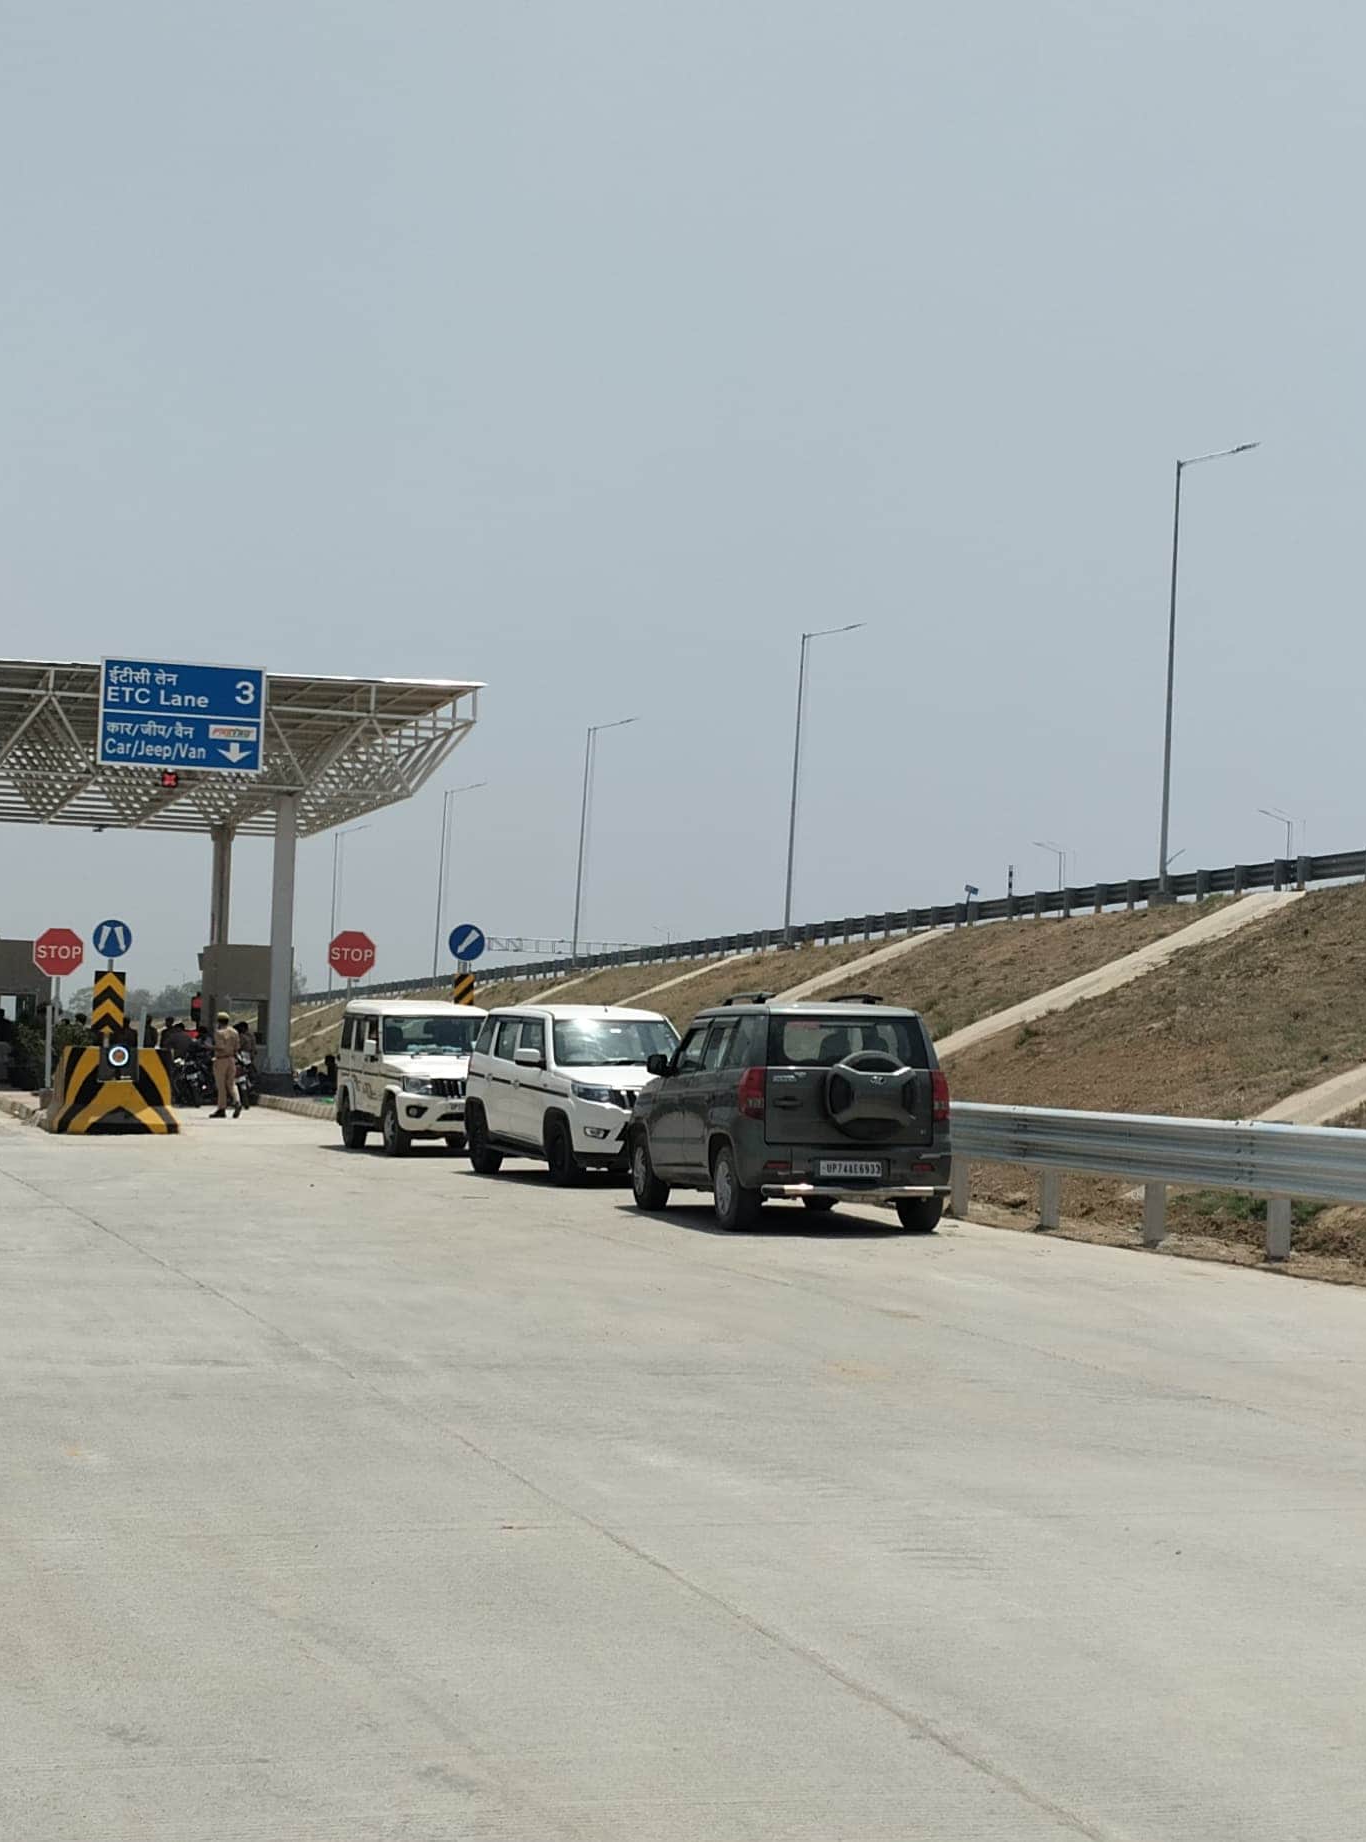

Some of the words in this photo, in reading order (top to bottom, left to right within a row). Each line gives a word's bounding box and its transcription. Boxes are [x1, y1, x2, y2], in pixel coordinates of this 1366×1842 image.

[108, 665, 151, 686] ईटीसी
[154, 668, 179, 686] लेन
[106, 686, 151, 704] ETC
[159, 689, 209, 708] Lane
[235, 681, 255, 705] 3
[105, 737, 206, 760] Car/Jeep/Van
[36, 945, 82, 960] STOP
[330, 947, 373, 963] STOP
